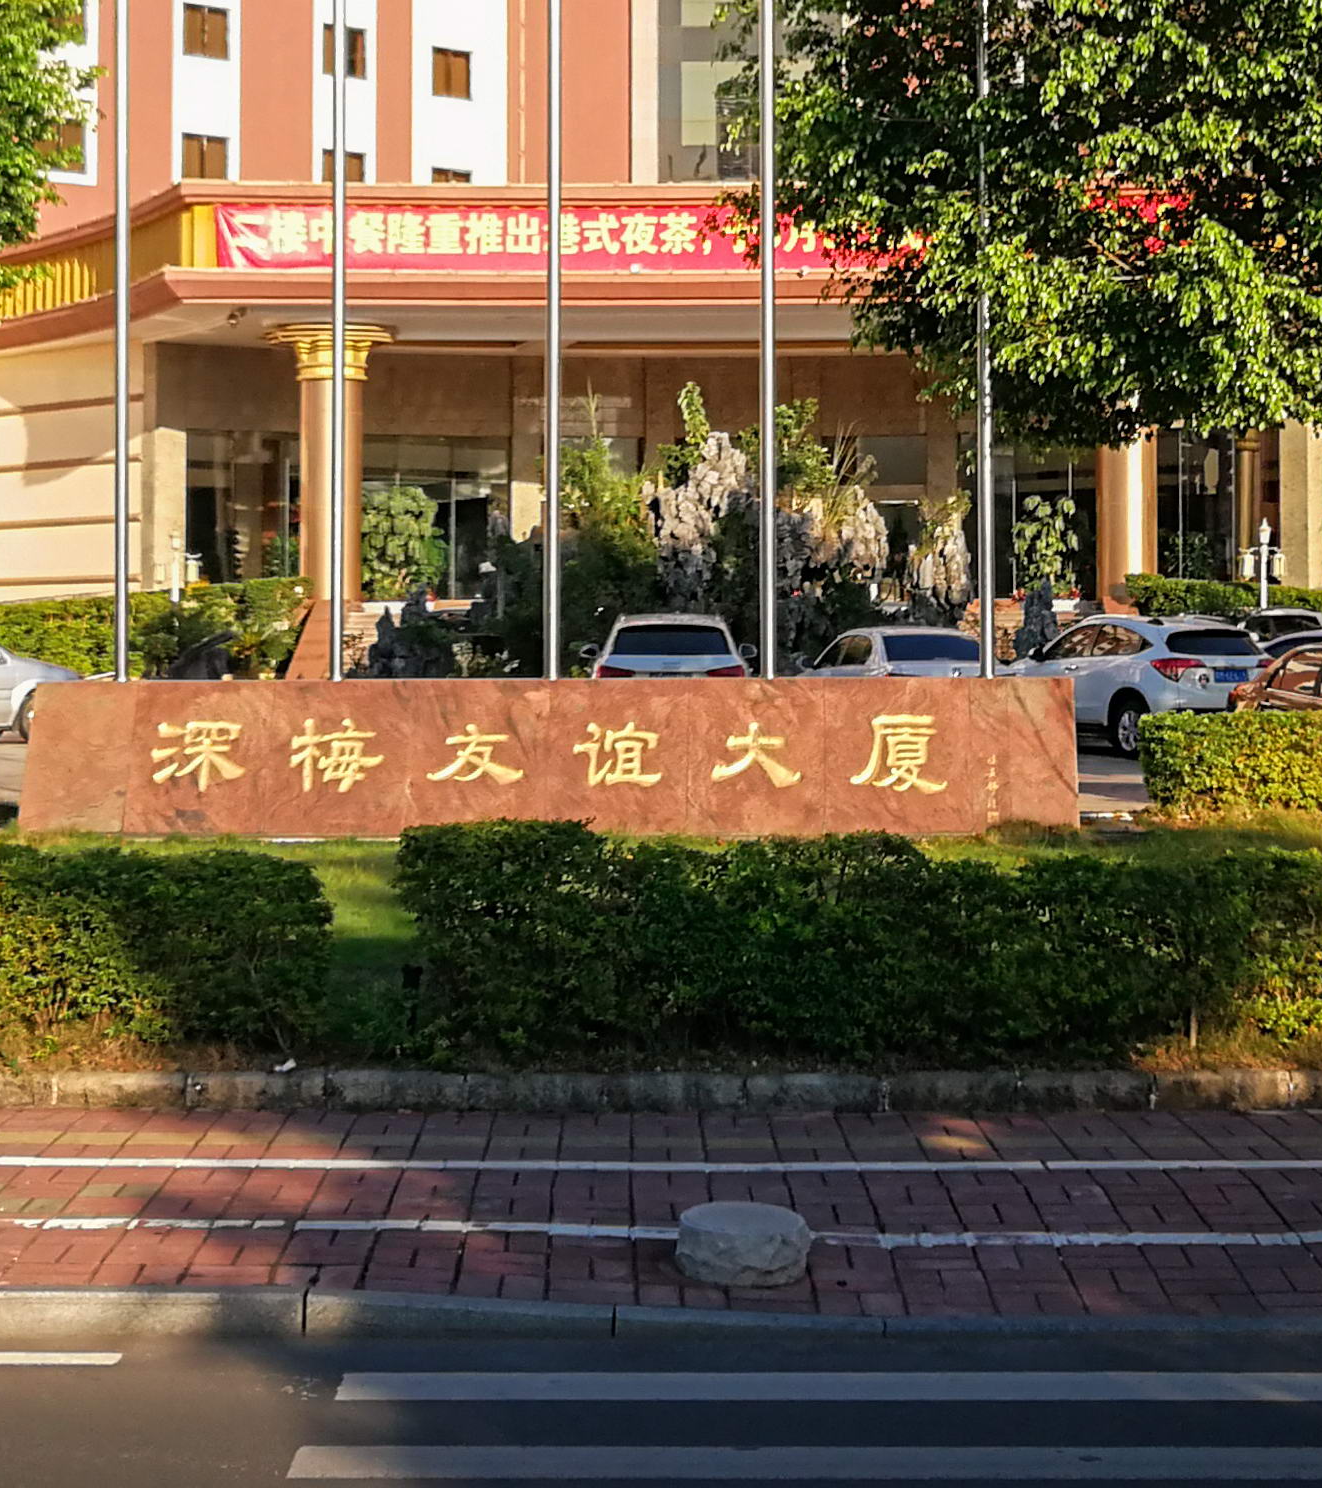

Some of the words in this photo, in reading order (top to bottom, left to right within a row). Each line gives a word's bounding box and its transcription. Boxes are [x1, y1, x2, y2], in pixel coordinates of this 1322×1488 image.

[150, 714, 948, 794] 深梅友谊大厦
